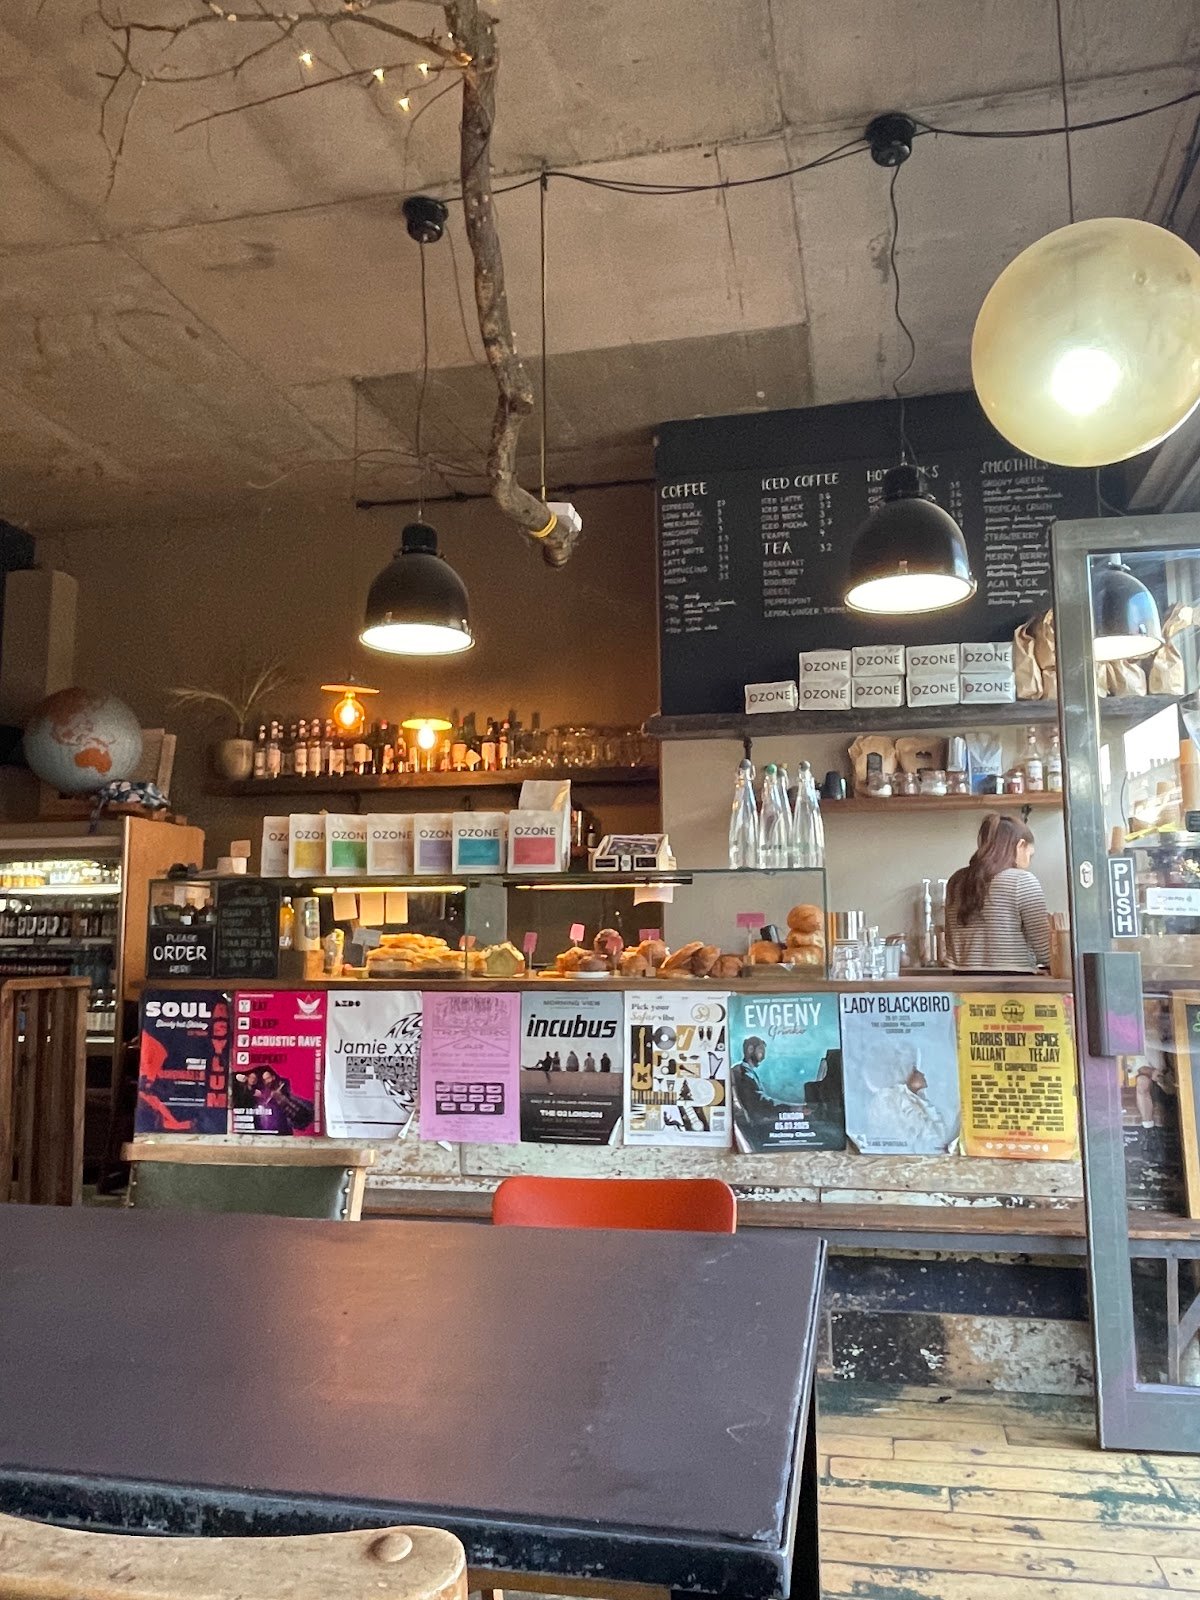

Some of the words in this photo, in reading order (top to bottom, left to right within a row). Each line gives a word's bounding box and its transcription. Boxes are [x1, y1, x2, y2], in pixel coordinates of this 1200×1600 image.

[761, 478, 790, 490] ICED
[794, 473, 839, 488] COFFEE
[1014, 476, 1044, 485] GREEN
[661, 482, 708, 499] COFFEE
[984, 532, 1039, 542] STRAWBERRY
[763, 541, 793, 555] TEA
[985, 553, 1014, 562] MERRY
[987, 580, 1009, 588] ACAI
[1015, 578, 1039, 587] KICK
[856, 655, 900, 666] OZONE
[910, 654, 956, 666] OZONE
[965, 652, 1010, 663] OZONE
[803, 661, 847, 672] OZONE
[855, 685, 900, 696] OZONE
[911, 684, 957, 696] OZONE
[964, 682, 1010, 693] OZONE
[750, 690, 791, 703] OZONE
[803, 689, 847, 700] OZONE
[373, 830, 412, 839] OZONE
[458, 828, 499, 837] OZONE
[514, 826, 556, 836] OZONE
[1113, 863, 1133, 933] PUSH
[166, 934, 198, 943] PLEASE
[153, 946, 207, 961] ORDER
[145, 1001, 212, 1018] SOUL
[631, 1003, 649, 1011] Pick
[651, 1004, 670, 1012] your
[844, 997, 875, 1014] LADY
[878, 996, 951, 1013] BLACKBIRD
[657, 1013, 675, 1022] vibe
[744, 1003, 821, 1028] EVGENY
[526, 1014, 618, 1038] incubus
[251, 1035, 296, 1047] ACOUSTIC
[297, 1036, 322, 1047] RAVE
[969, 1032, 1003, 1046] TARRUS
[1004, 1032, 1026, 1046] RILEY
[1034, 1033, 1059, 1047] SPICE
[334, 1039, 388, 1055] Jamie
[393, 1043, 414, 1054] xx
[206, 1003, 228, 1108] ASYLUM
[970, 1047, 1006, 1061] VALIANT
[1029, 1048, 1061, 1062] TEEJAY
[540, 1109, 556, 1117] THE
[779, 1112, 804, 1120] LONDON
